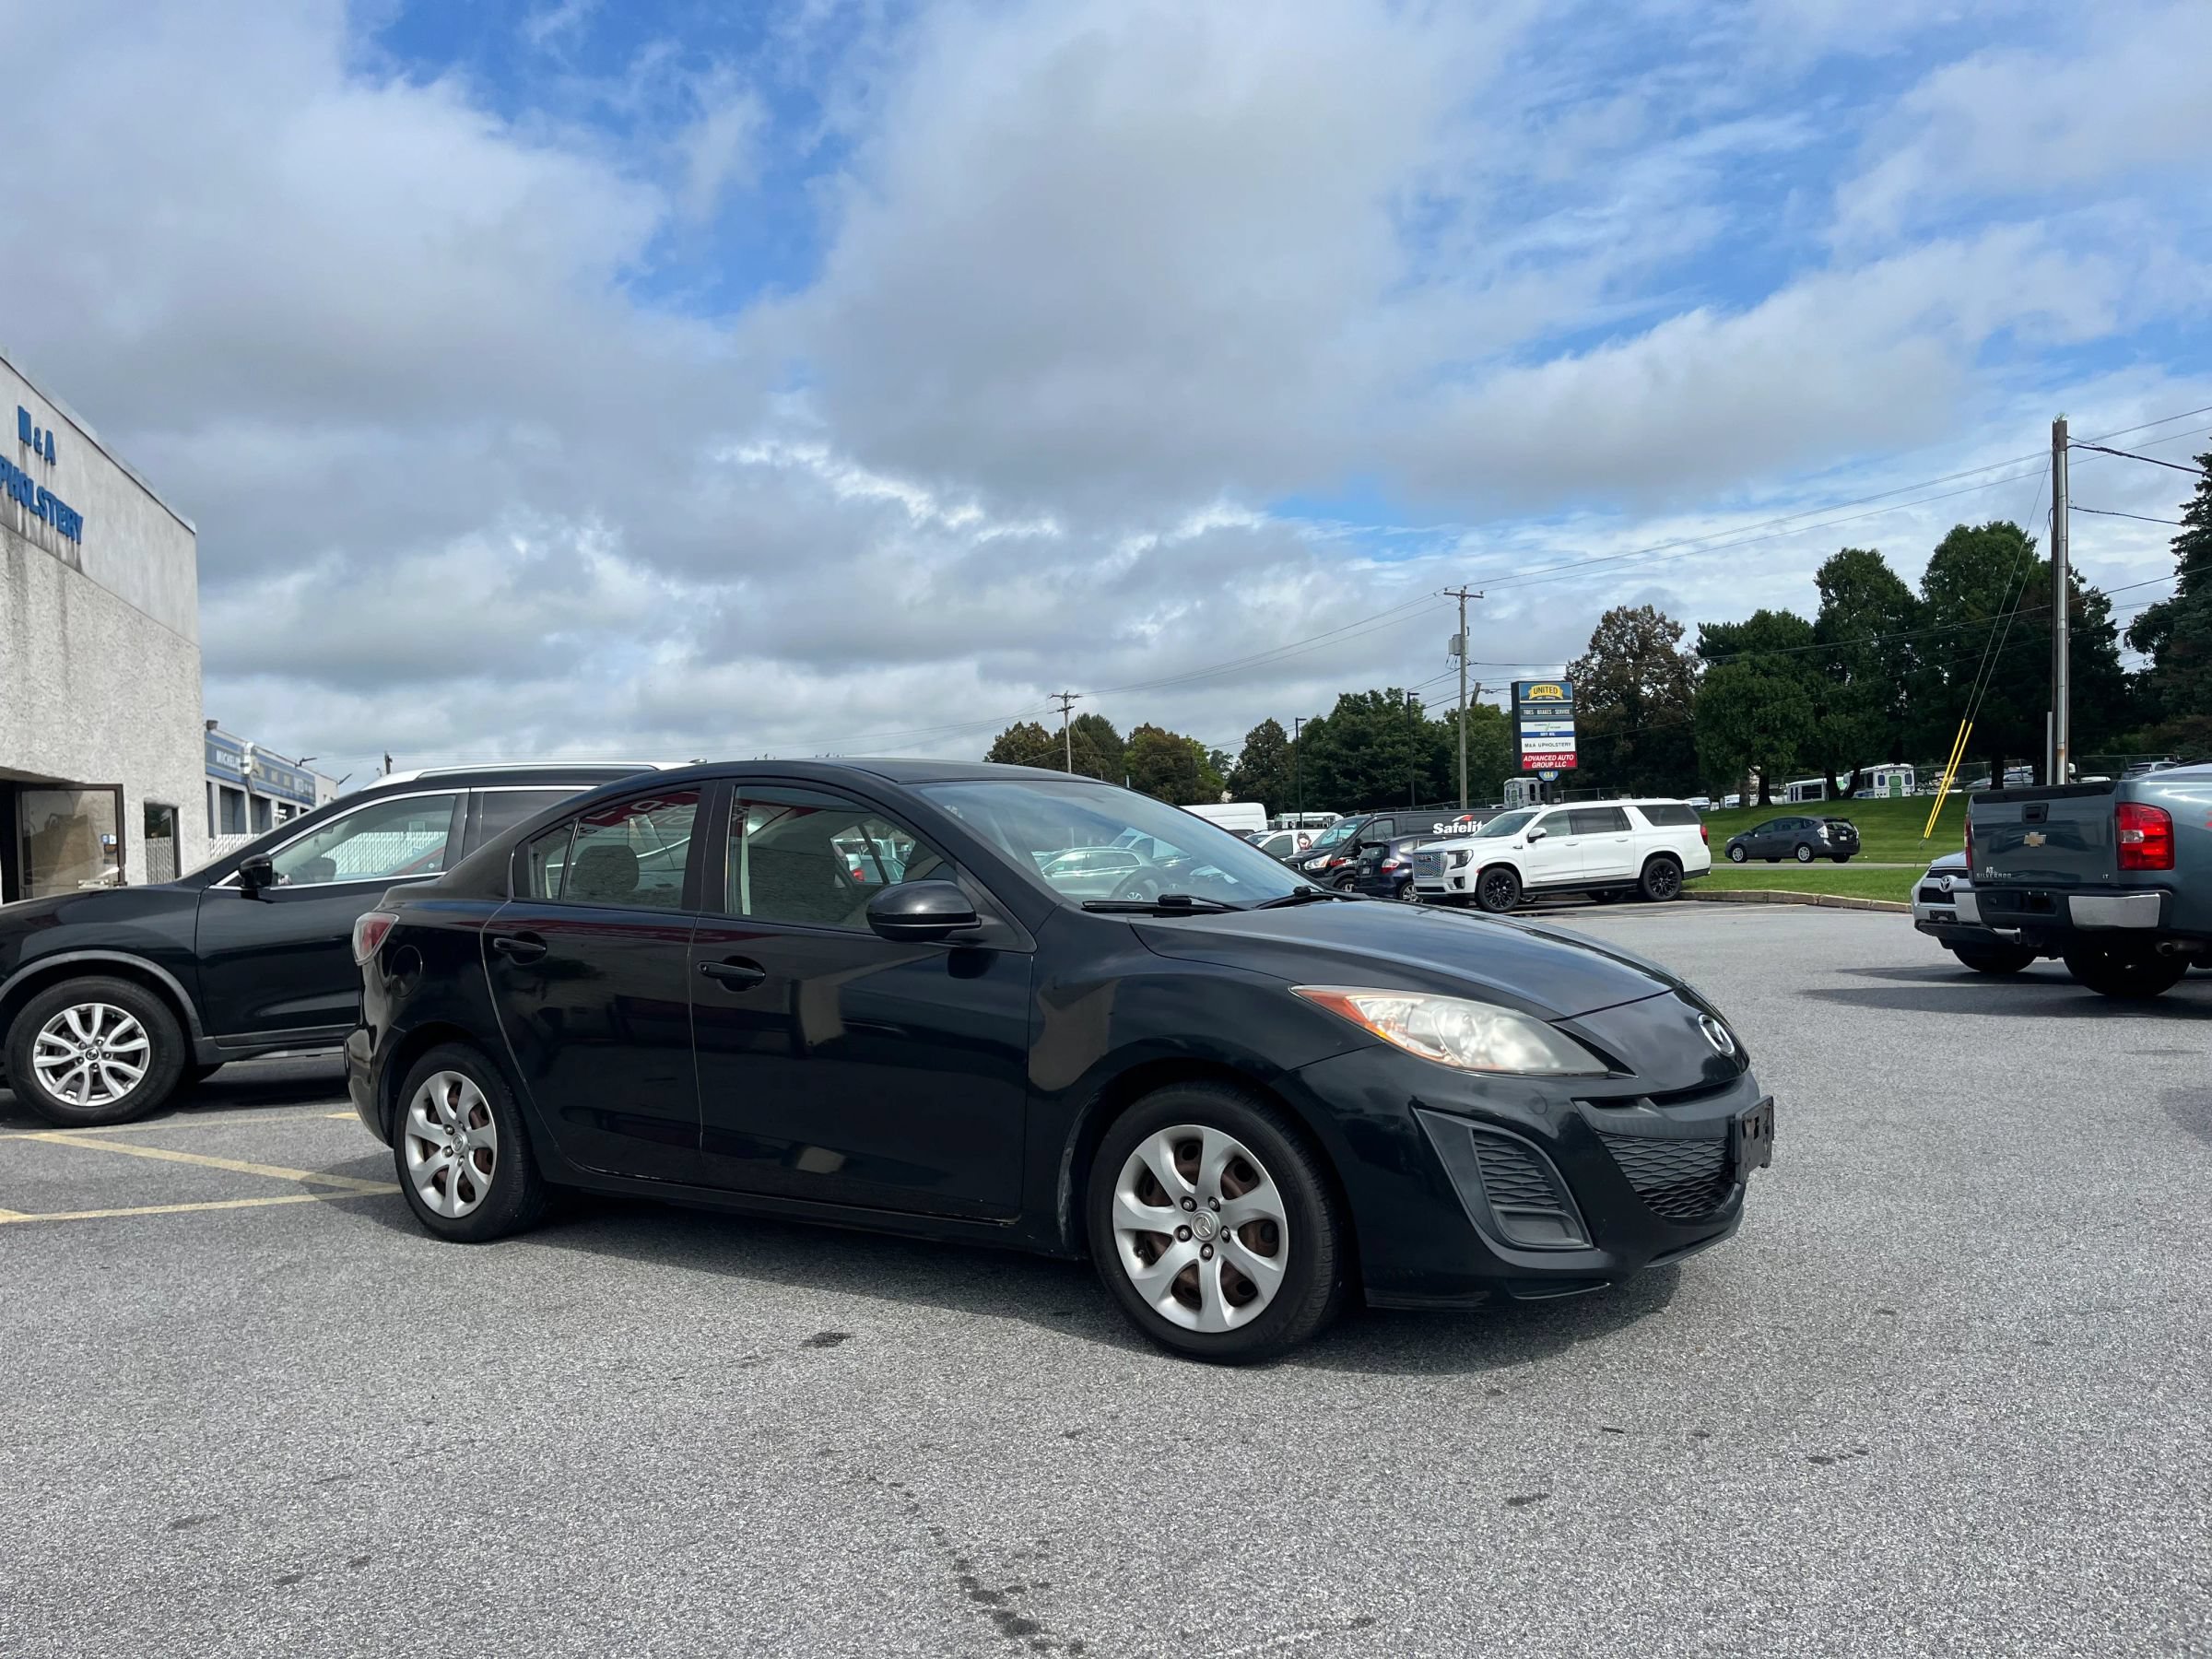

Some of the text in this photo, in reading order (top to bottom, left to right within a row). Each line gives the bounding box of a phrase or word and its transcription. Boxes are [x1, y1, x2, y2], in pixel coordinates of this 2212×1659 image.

[0, 453, 84, 545] PHOLSTERY
[1533, 686, 1559, 695] UNITED
[1432, 820, 1483, 834] Safelit
